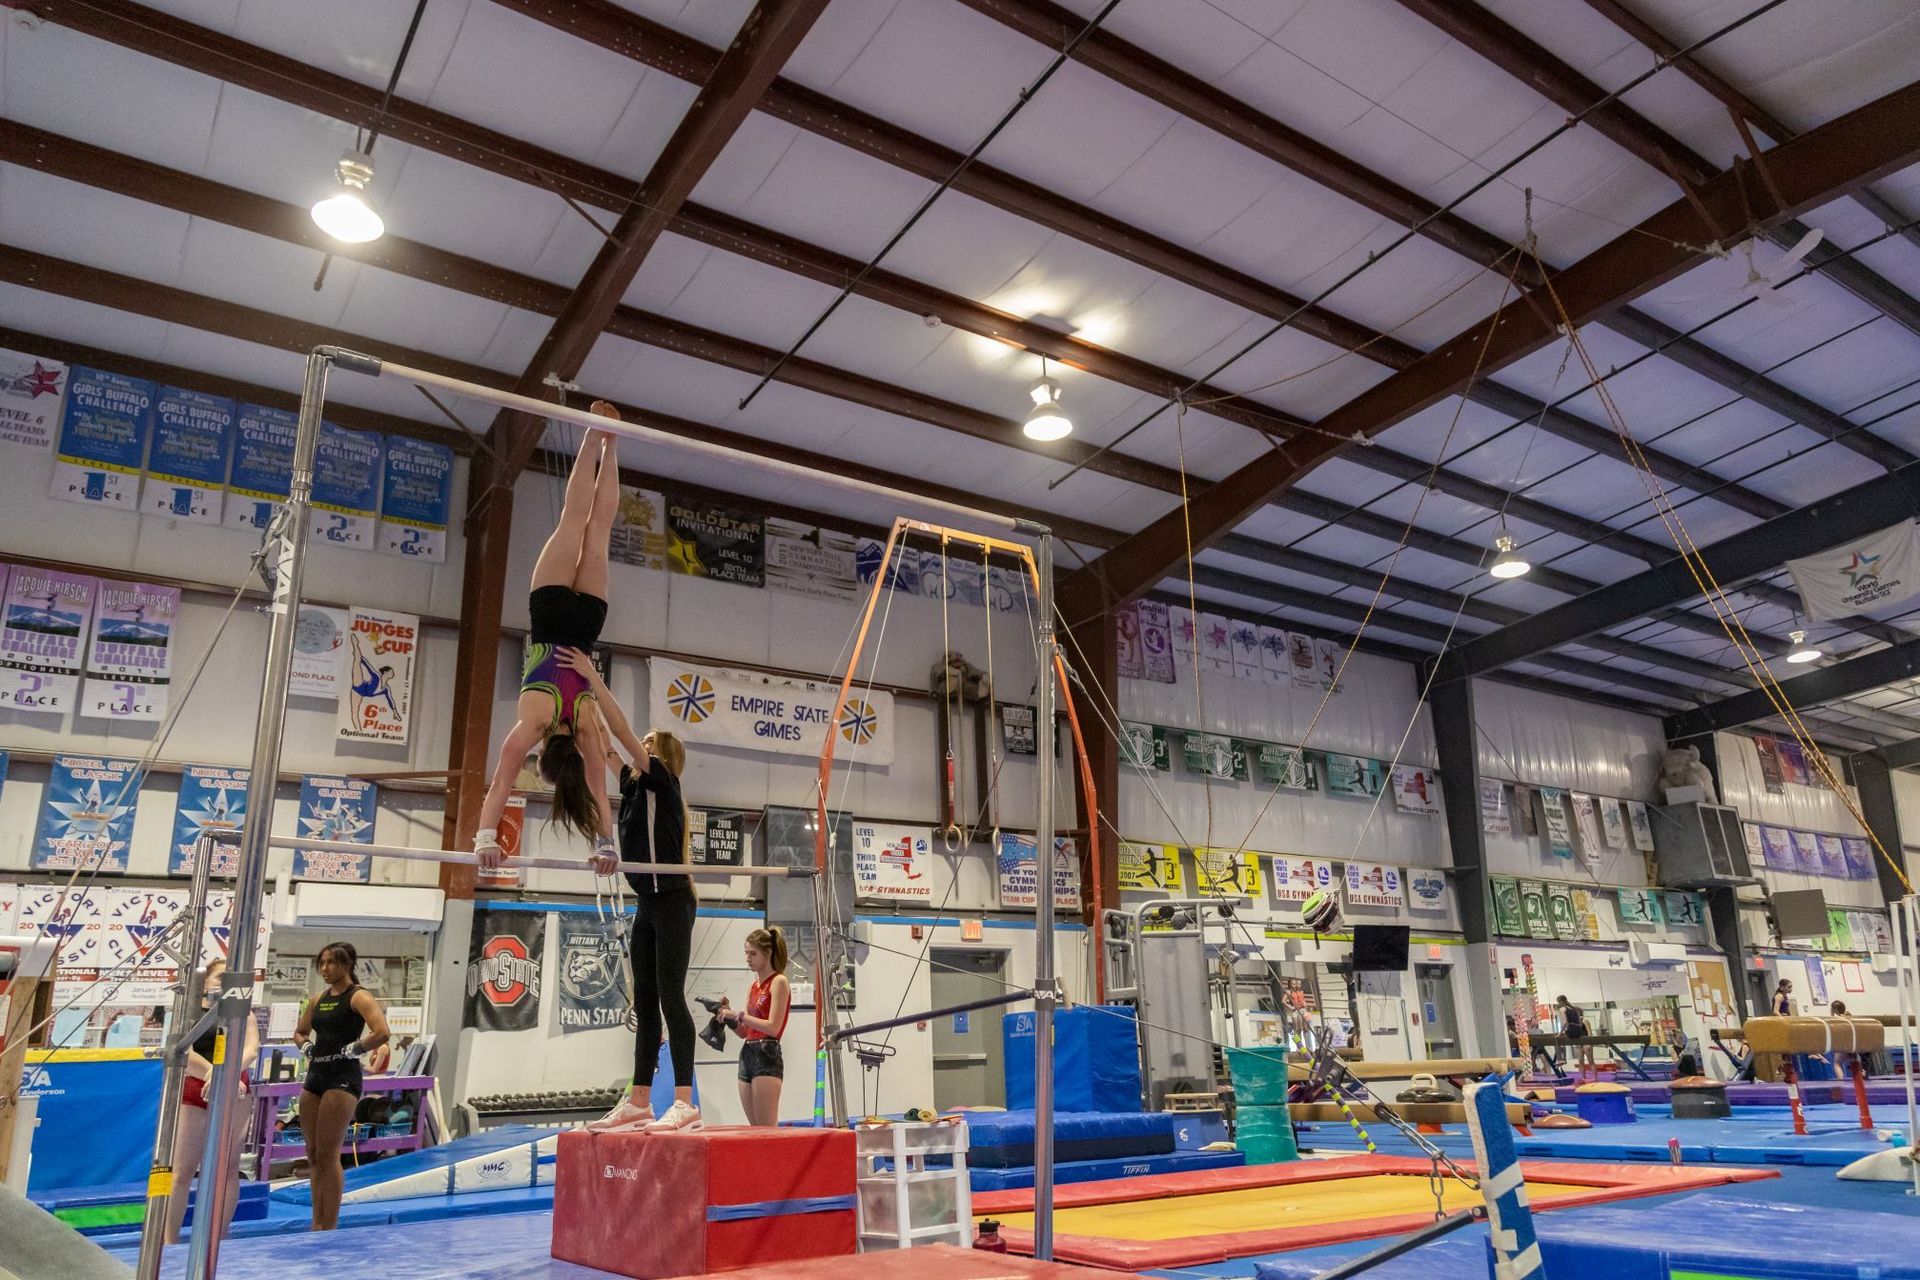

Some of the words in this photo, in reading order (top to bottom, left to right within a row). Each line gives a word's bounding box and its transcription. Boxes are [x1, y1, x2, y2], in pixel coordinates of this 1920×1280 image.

[73, 382, 103, 397] GIRLS
[106, 389, 150, 409] BUFFALO
[77, 394, 141, 416] CHALLENGE
[0, 407, 31, 423] EVEL
[36, 415, 45, 425] 6
[159, 401, 187, 416] GIRLS
[190, 407, 231, 426] BUFFALO
[163, 413, 223, 433] CHALLENGE
[240, 418, 266, 432] GIRLS
[269, 424, 297, 438] BUFFA
[243, 429, 294, 447] CHALLENG
[320, 445, 372, 466] CHALLENGE
[343, 440, 379, 457] BUFFALO
[388, 449, 412, 463] GIRLS
[414, 454, 449, 471] BUFFALO
[392, 461, 443, 478] CHALLENGE
[69, 485, 122, 500] PLACE
[158, 501, 208, 516] PLACE
[316, 527, 362, 542] PLACE
[676, 518, 755, 544] INVITATIONAL
[390, 541, 433, 555] PLACE
[718, 549, 740, 561] LEVEL
[742, 552, 753, 563] 10
[710, 568, 736, 580] PLACE
[737, 573, 760, 584] TEAM
[13, 575, 52, 594] JACQUIE
[55, 580, 89, 603] HIRSCH
[1842, 589, 1875, 604] University
[1874, 579, 1902, 593] Games
[1857, 580, 1878, 592] World
[101, 589, 138, 608] JACQUIE
[141, 593, 173, 613] HIRSCH
[1855, 593, 1880, 606] Buffalo
[351, 619, 414, 640] JUDGES
[3, 629, 78, 649] BUFFALO
[1, 639, 76, 659] CHALLENGE
[95, 643, 167, 658] BUFFALO
[382, 639, 414, 655] CUP
[7, 652, 67, 665] 2011
[95, 653, 166, 669] CHALLENGE
[101, 666, 158, 675] 2011
[311, 673, 336, 682] PLACE
[103, 674, 142, 683] LEVEL
[1, 691, 59, 705] PLACE
[98, 702, 153, 713] PLACE
[732, 695, 785, 718] EMPIRE
[793, 705, 830, 724] STATE
[362, 719, 403, 732] Place
[754, 720, 802, 741] GAMES
[340, 727, 379, 740] Optional
[382, 731, 405, 742] Team
[61, 757, 106, 771] NICKEL
[107, 760, 137, 772] CITY
[71, 768, 123, 782] CLASSIC
[191, 767, 232, 781] NICKEL
[232, 769, 251, 780] CIT
[199, 778, 248, 791] CLASSIC
[310, 777, 347, 788] NICKEL
[347, 780, 372, 791] CITY
[318, 788, 363, 800] CLASSIC
[709, 829, 726, 839] LEVEL
[855, 828, 875, 837] LEVEL
[720, 840, 738, 850] PLACE
[862, 837, 871, 848] 10
[716, 850, 732, 860] TEAM
[856, 853, 876, 862] THIRD
[308, 861, 346, 870] LEVEL
[856, 863, 877, 871] PLACE
[327, 868, 361, 879] PLACE
[858, 873, 877, 881] TEAM
[1120, 871, 1135, 880] 2007
[877, 886, 931, 895] GYMNASTICS
[1277, 889, 1291, 899] USA
[23, 892, 102, 916] VICTORY
[112, 893, 179, 918] VICTOR
[1002, 895, 1021, 904] TEAM
[1021, 896, 1036, 904] CUP
[1056, 897, 1078, 905] PLACE
[1349, 894, 1362, 903] USA
[1363, 894, 1402, 906] GYMNASTICS
[20, 922, 35, 930] 20
[86, 923, 102, 931] 20
[569, 936, 600, 946] NITTANY
[108, 939, 181, 966] CLASSC
[561, 1008, 591, 1025] PENN
[1123, 1164, 1151, 1175] TIFFIN
